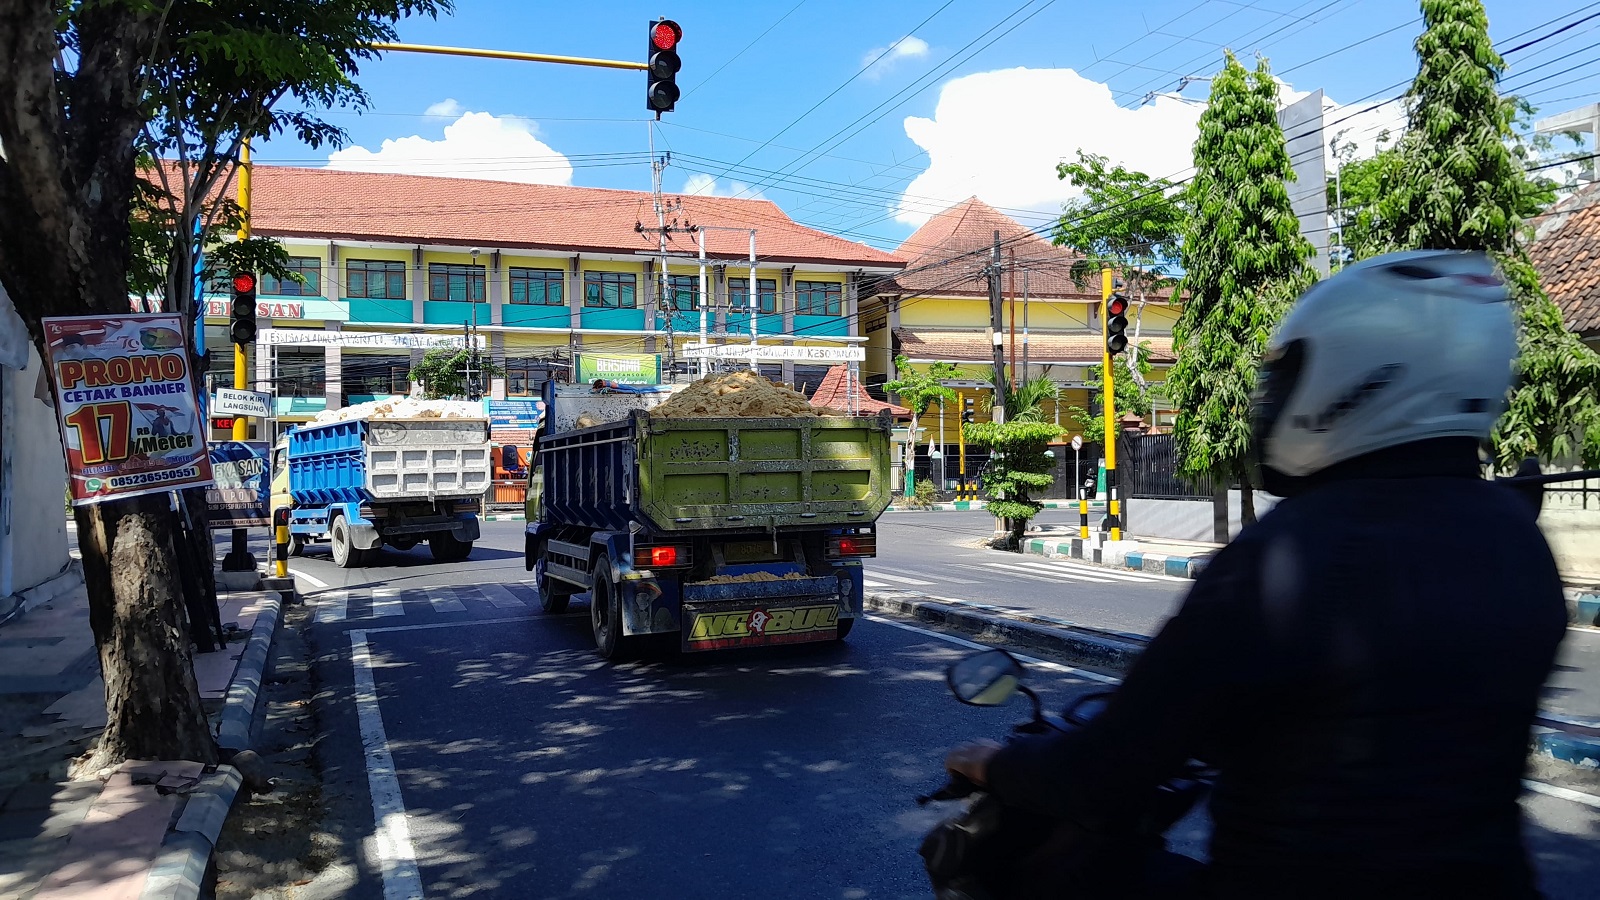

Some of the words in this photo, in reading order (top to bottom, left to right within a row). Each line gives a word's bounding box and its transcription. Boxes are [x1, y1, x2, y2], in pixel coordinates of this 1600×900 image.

[59, 353, 185, 389] PROMO
[597, 359, 640, 372] BERSAMA
[63, 387, 117, 403] CETAK
[121, 382, 187, 398] BANNER
[223, 393, 248, 402] BELOK
[249, 395, 265, 403] KIRI
[223, 402, 264, 413] LANGSUNG
[65, 400, 132, 464] 17
[136, 427, 151, 436] RB
[134, 435, 194, 455] /Meter
[110, 467, 196, 487] 085236550551
